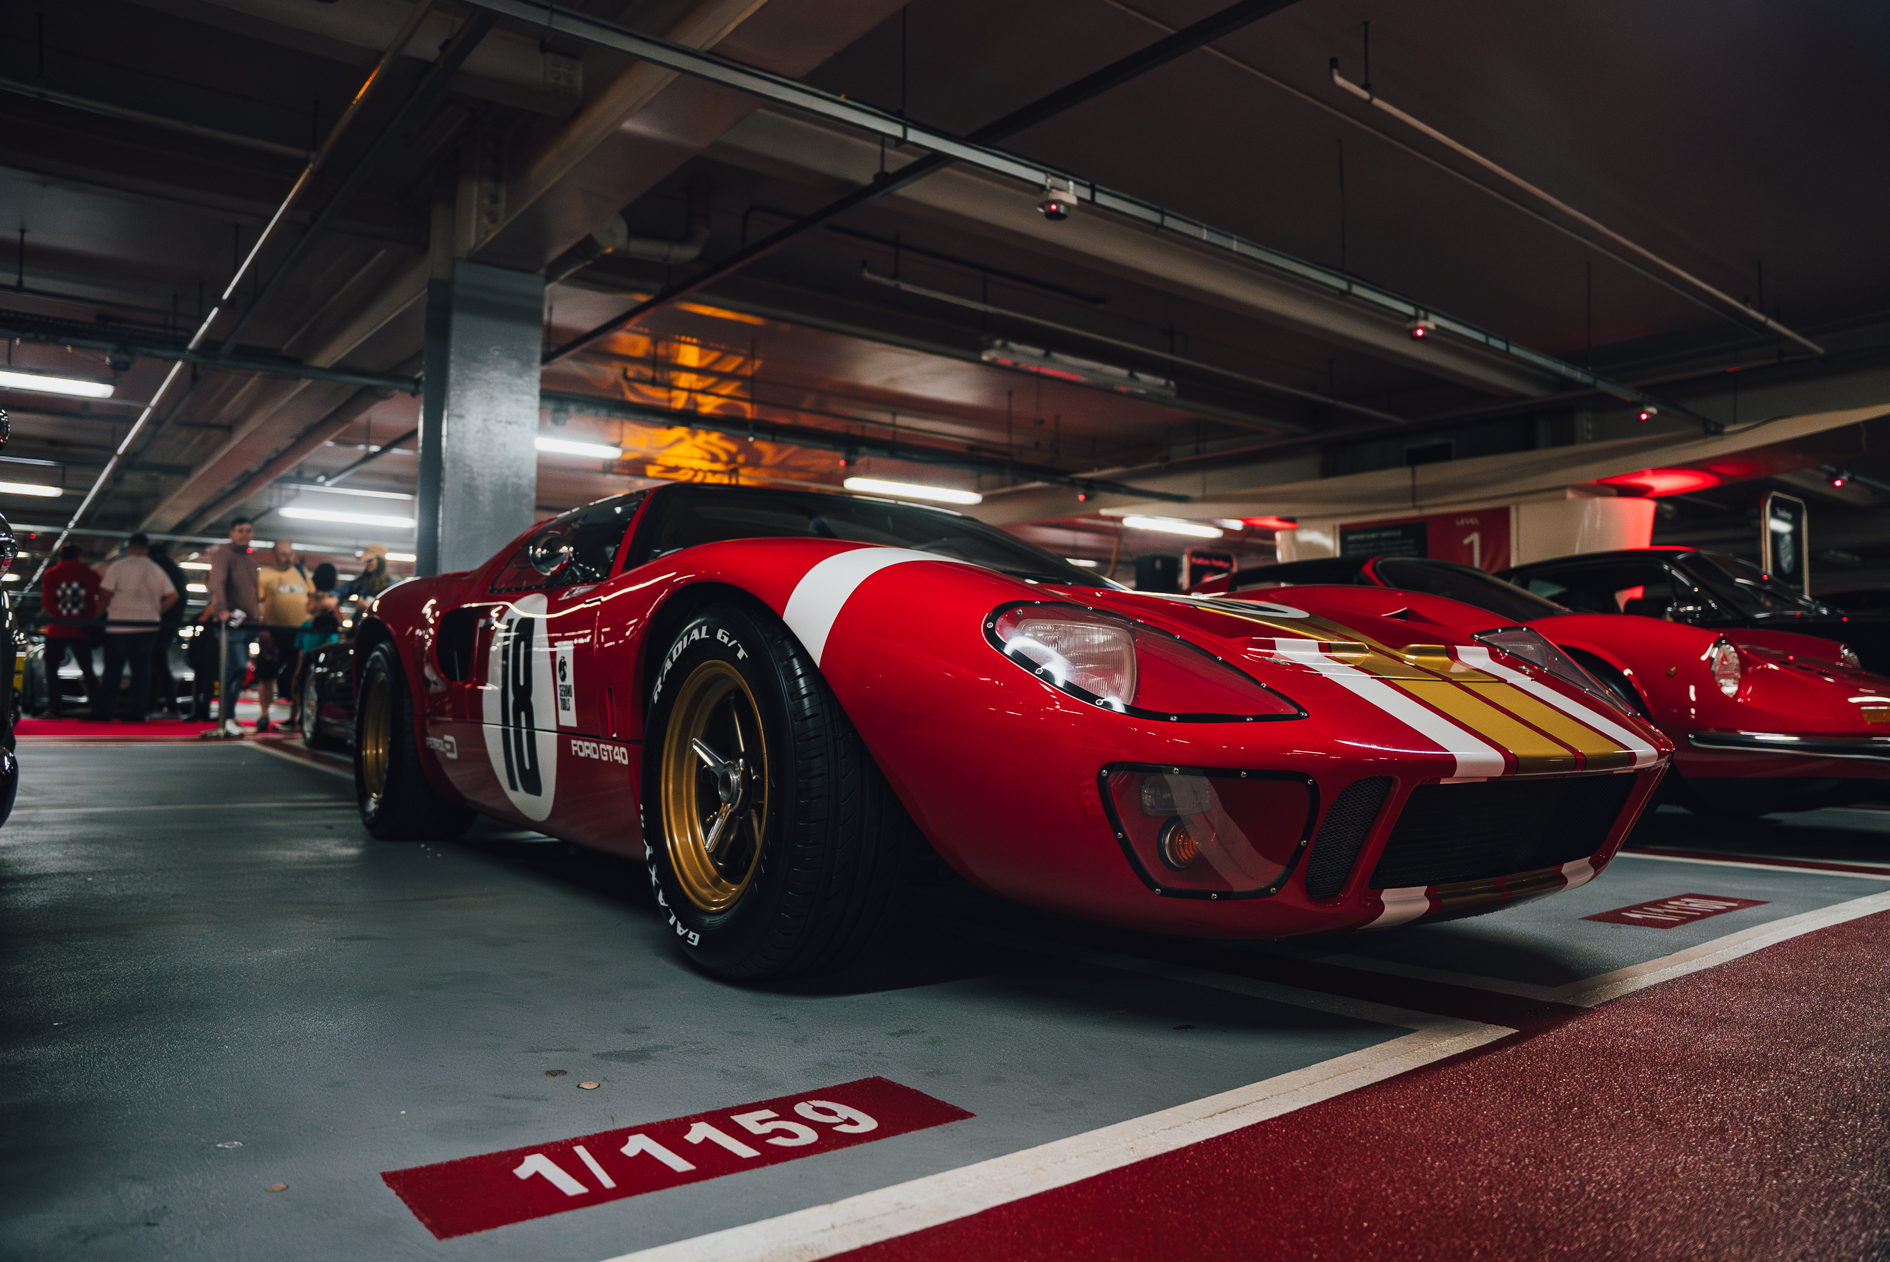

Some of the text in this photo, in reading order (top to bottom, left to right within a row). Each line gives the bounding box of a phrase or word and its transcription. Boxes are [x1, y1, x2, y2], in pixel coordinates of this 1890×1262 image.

[1455, 516, 1479, 527] LEVEL
[1462, 531, 1480, 569] 1
[652, 625, 749, 704] RADIAL G/T
[501, 617, 542, 797] 18
[571, 739, 629, 765] FORD GT40
[642, 838, 702, 947] GALAXY
[512, 1099, 880, 1198] 1/1159
